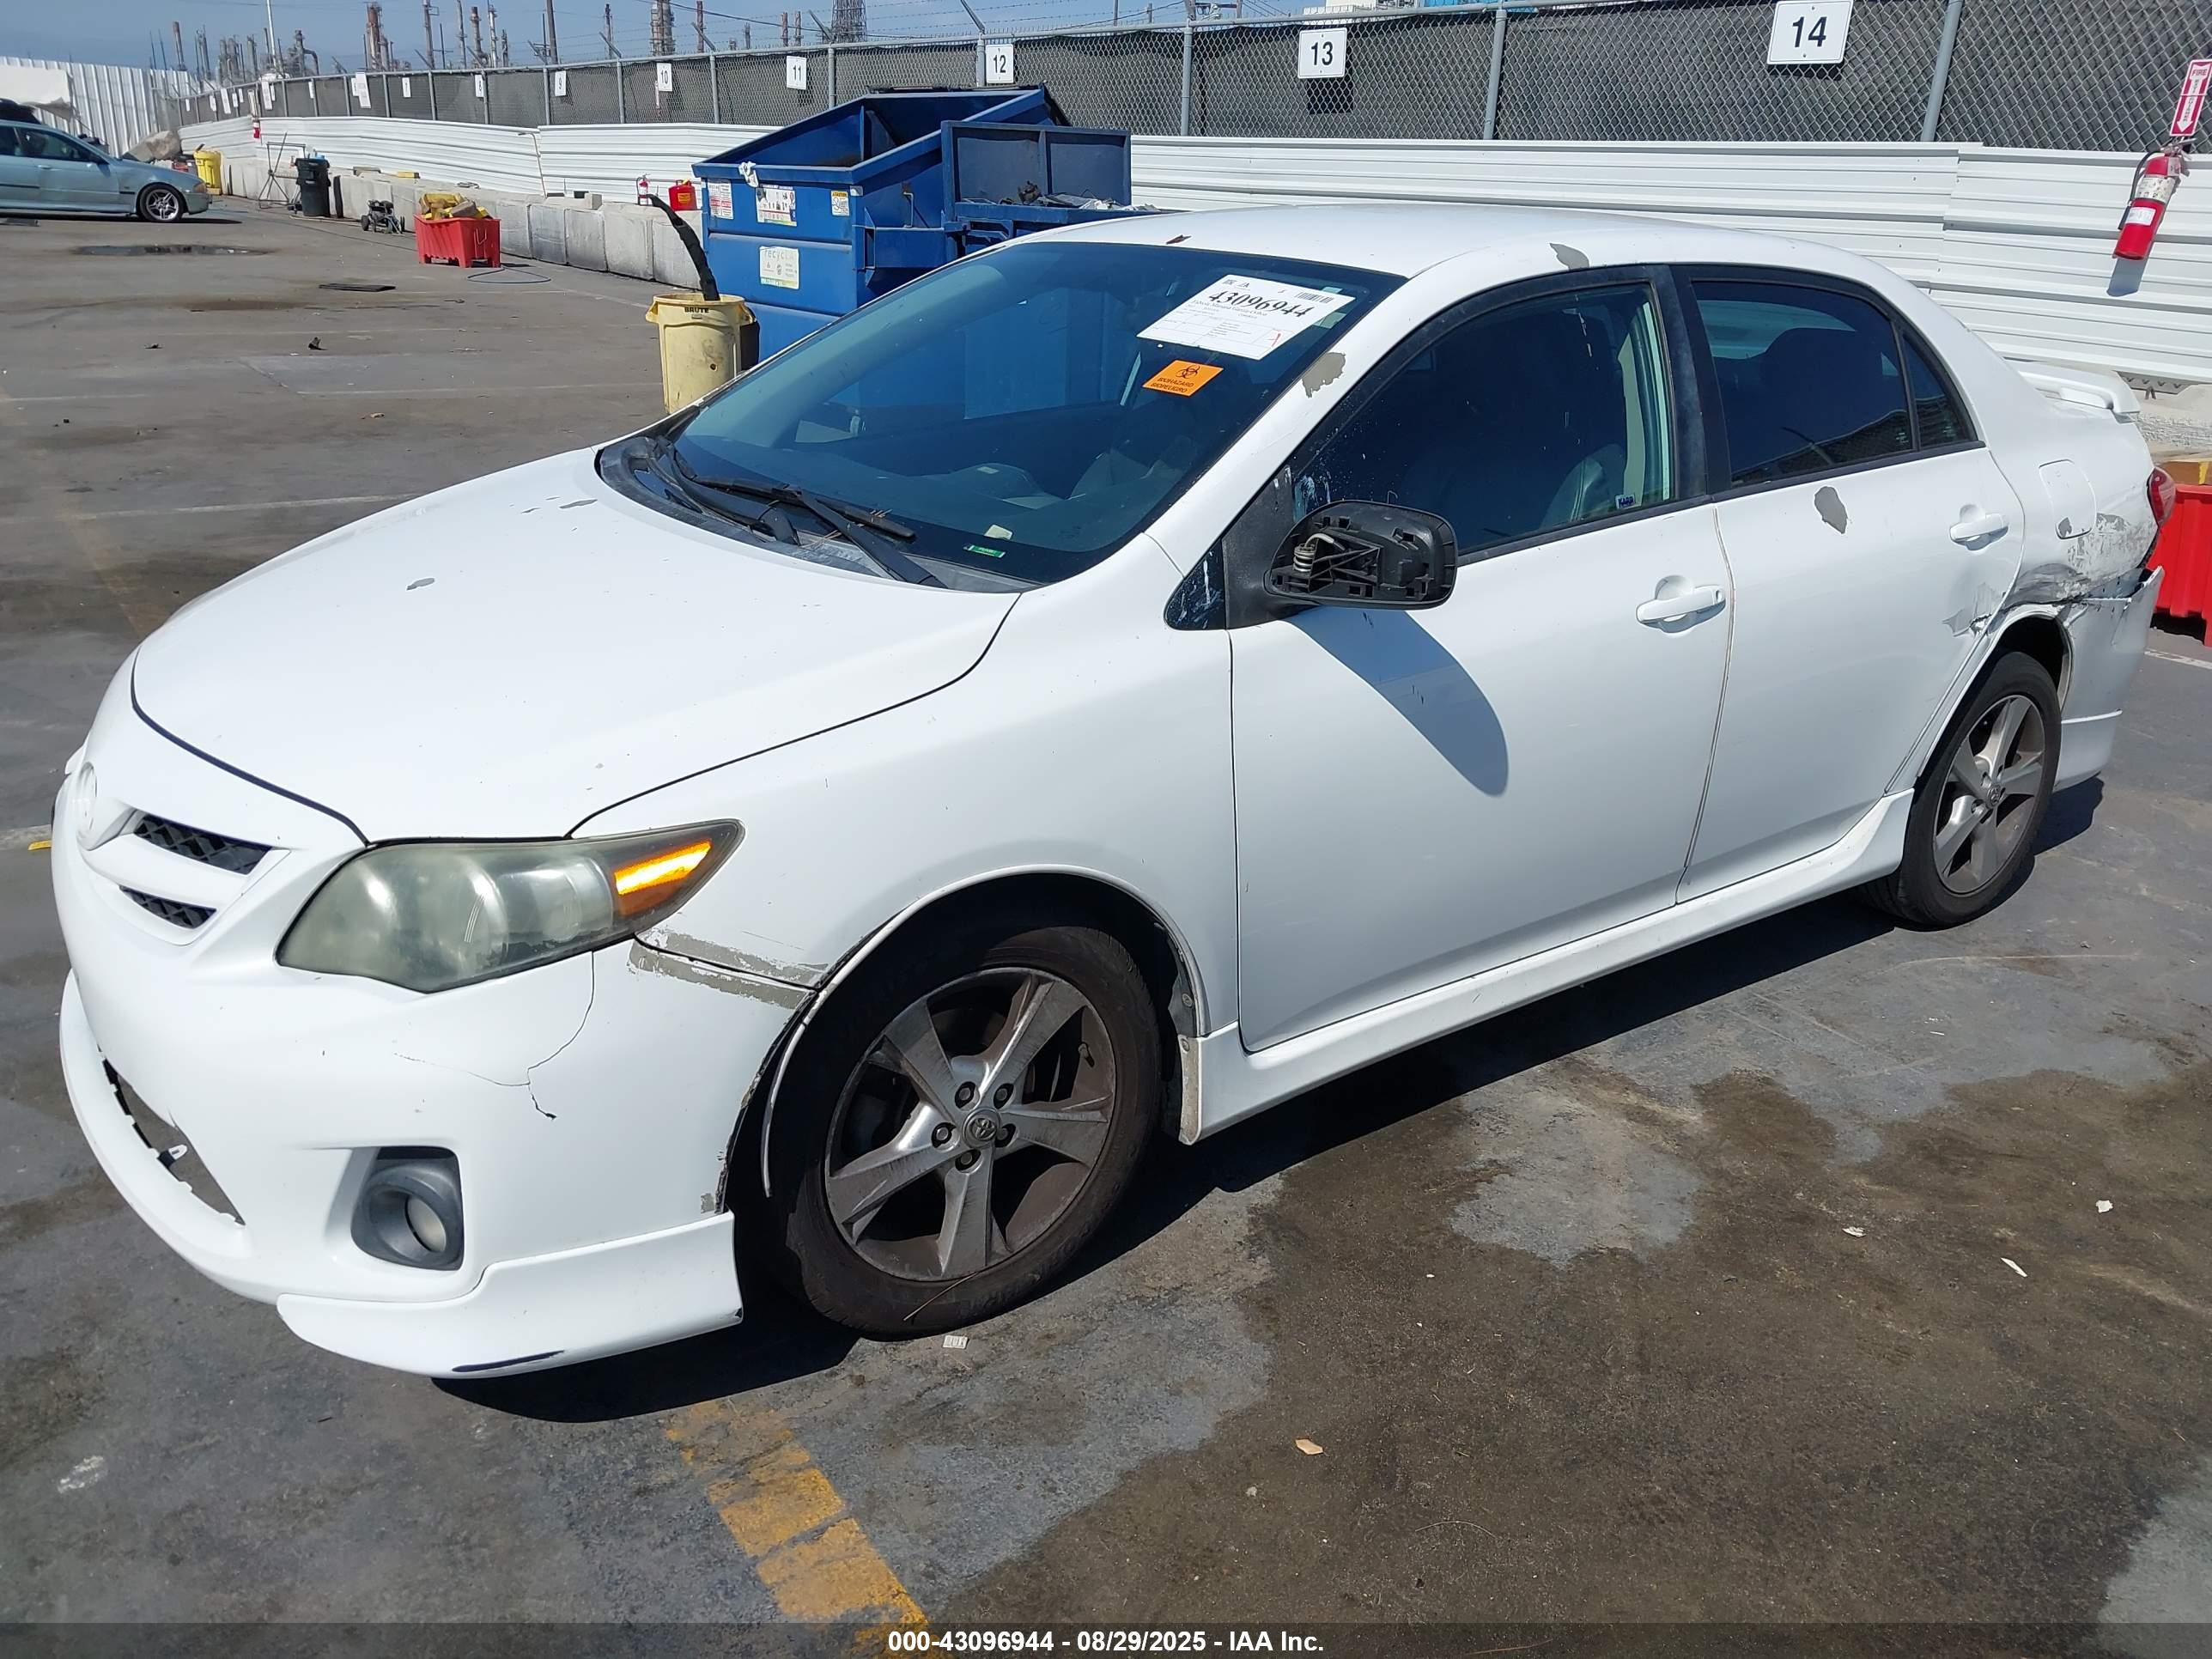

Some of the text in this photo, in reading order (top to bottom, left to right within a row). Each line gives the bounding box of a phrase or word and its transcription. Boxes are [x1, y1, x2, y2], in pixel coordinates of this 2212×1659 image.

[1792, 16, 1827, 48] 14
[1310, 40, 1334, 66] 13
[793, 64, 802, 82] 11
[993, 54, 1006, 74] 12
[558, 76, 562, 89] 9
[660, 70, 669, 85] 10
[1208, 290, 1316, 318] 43096944
[1157, 376, 1194, 387] BIOHAZARD
